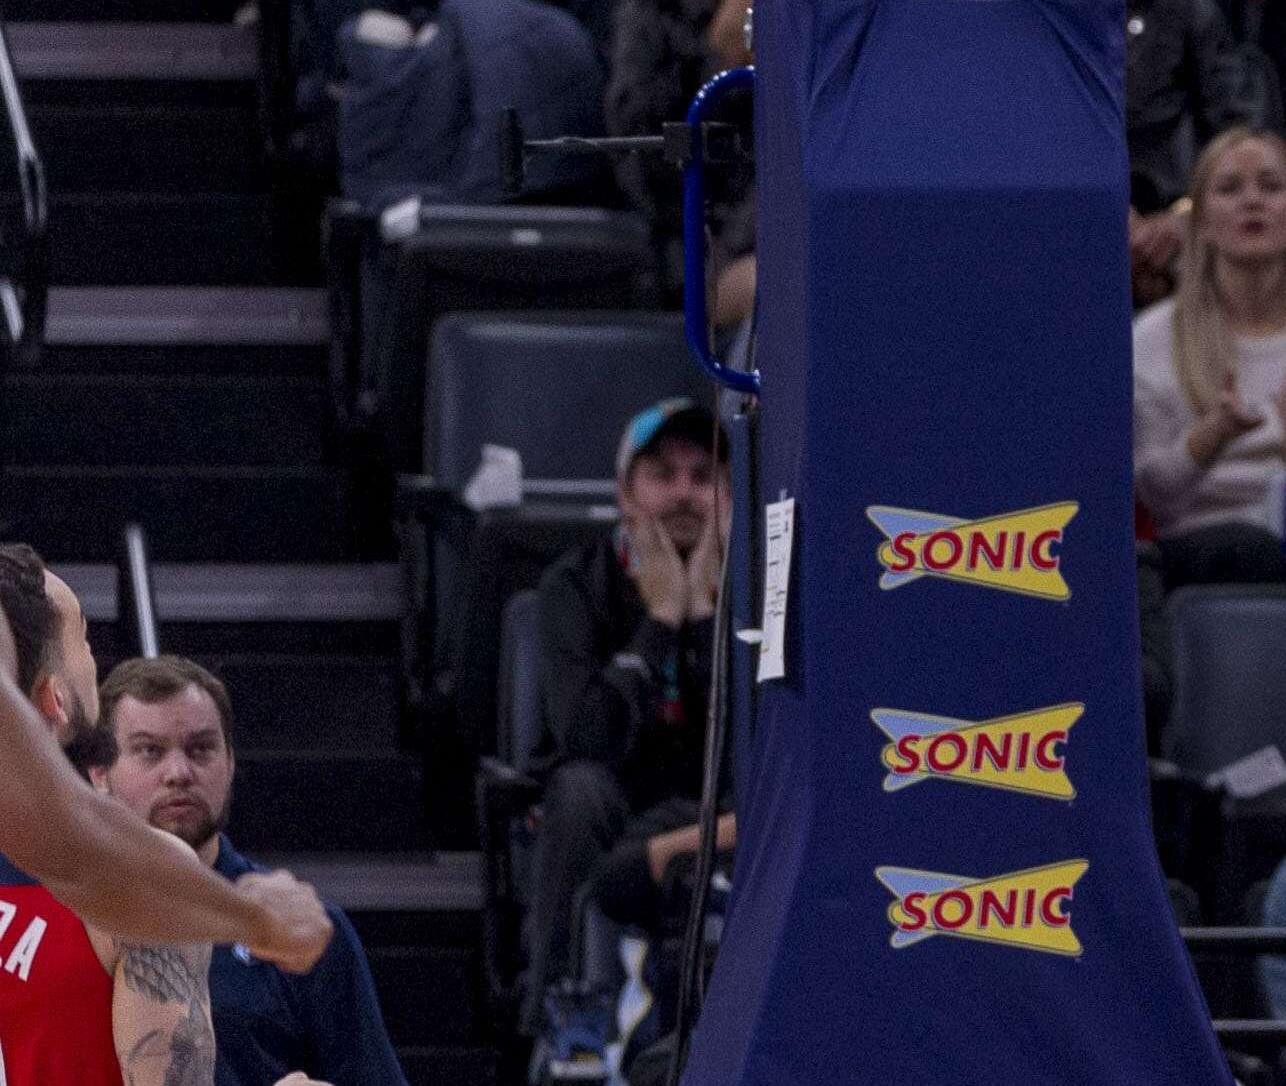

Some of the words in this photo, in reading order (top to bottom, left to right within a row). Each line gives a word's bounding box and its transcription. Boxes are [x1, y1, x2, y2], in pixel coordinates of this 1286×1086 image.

[889, 529, 1063, 574] SONIC
[892, 729, 1068, 776] SONIC
[898, 885, 1073, 932] SONIC
